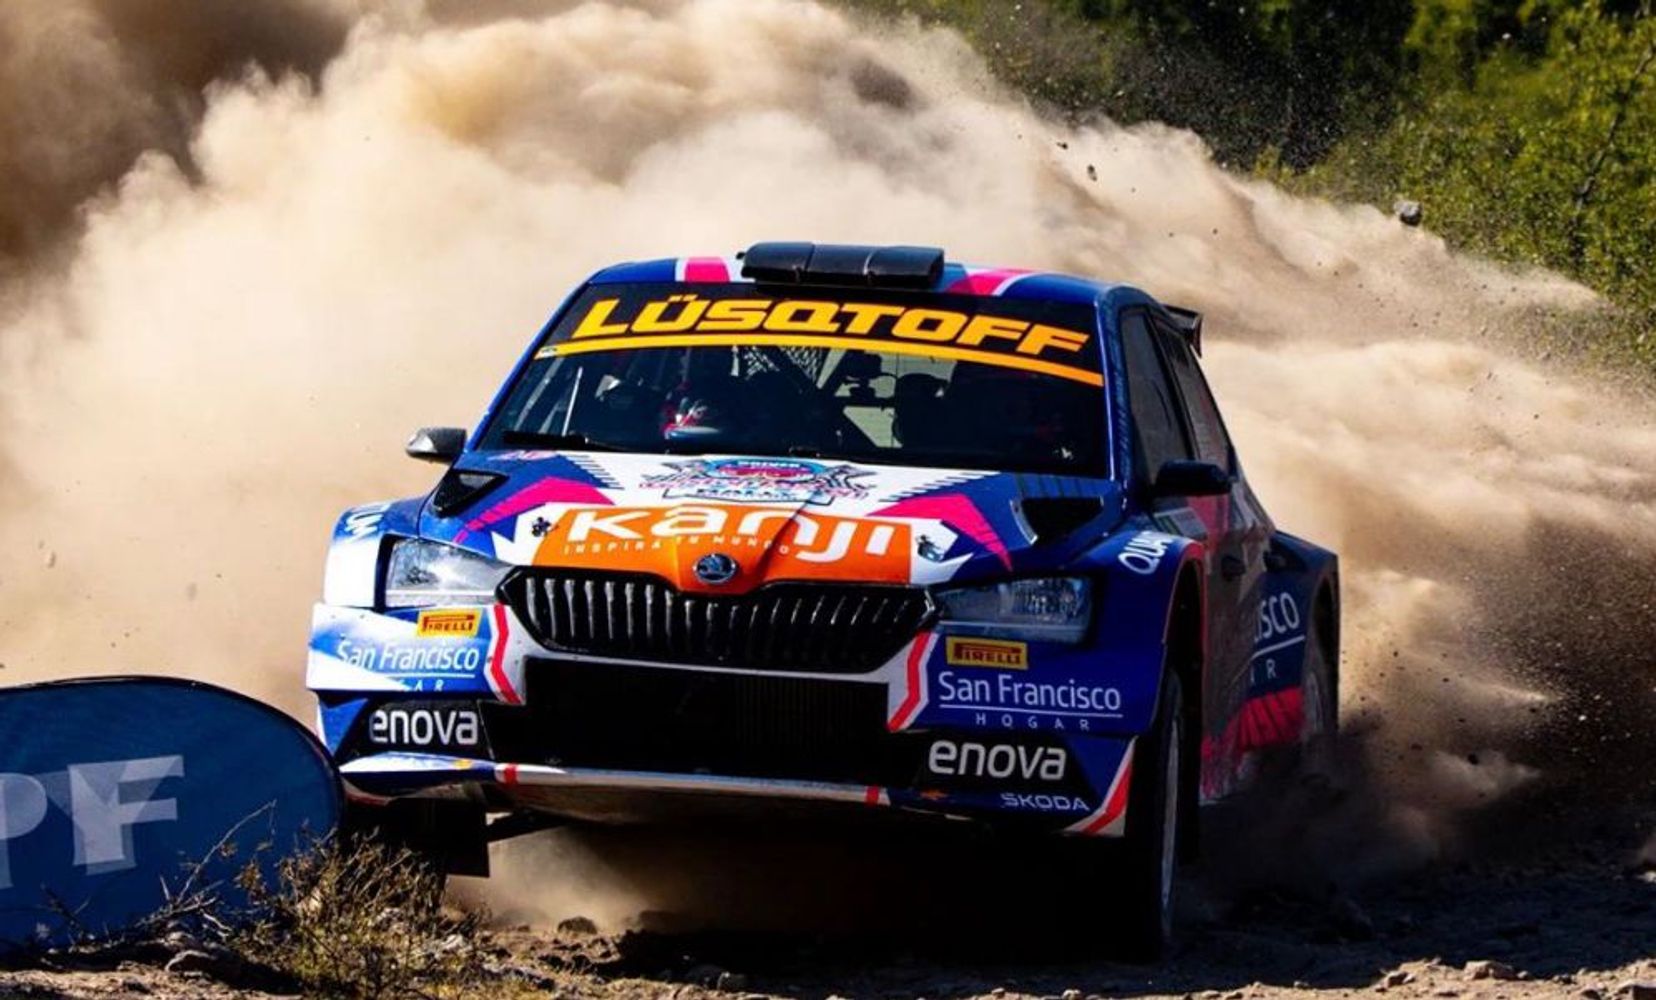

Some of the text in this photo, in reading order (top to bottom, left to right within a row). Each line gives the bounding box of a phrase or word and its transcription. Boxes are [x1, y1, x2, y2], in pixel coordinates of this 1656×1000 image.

[572, 293, 1090, 355] LÜSQTOFF
[421, 613, 476, 633] PIRELLI
[337, 638, 479, 670] San Francisco
[954, 643, 1024, 664] PIRELLI
[938, 671, 1121, 710] San Francisco
[368, 709, 479, 746] enova
[975, 712, 1090, 731] HOGAR
[928, 739, 1067, 780] enova
